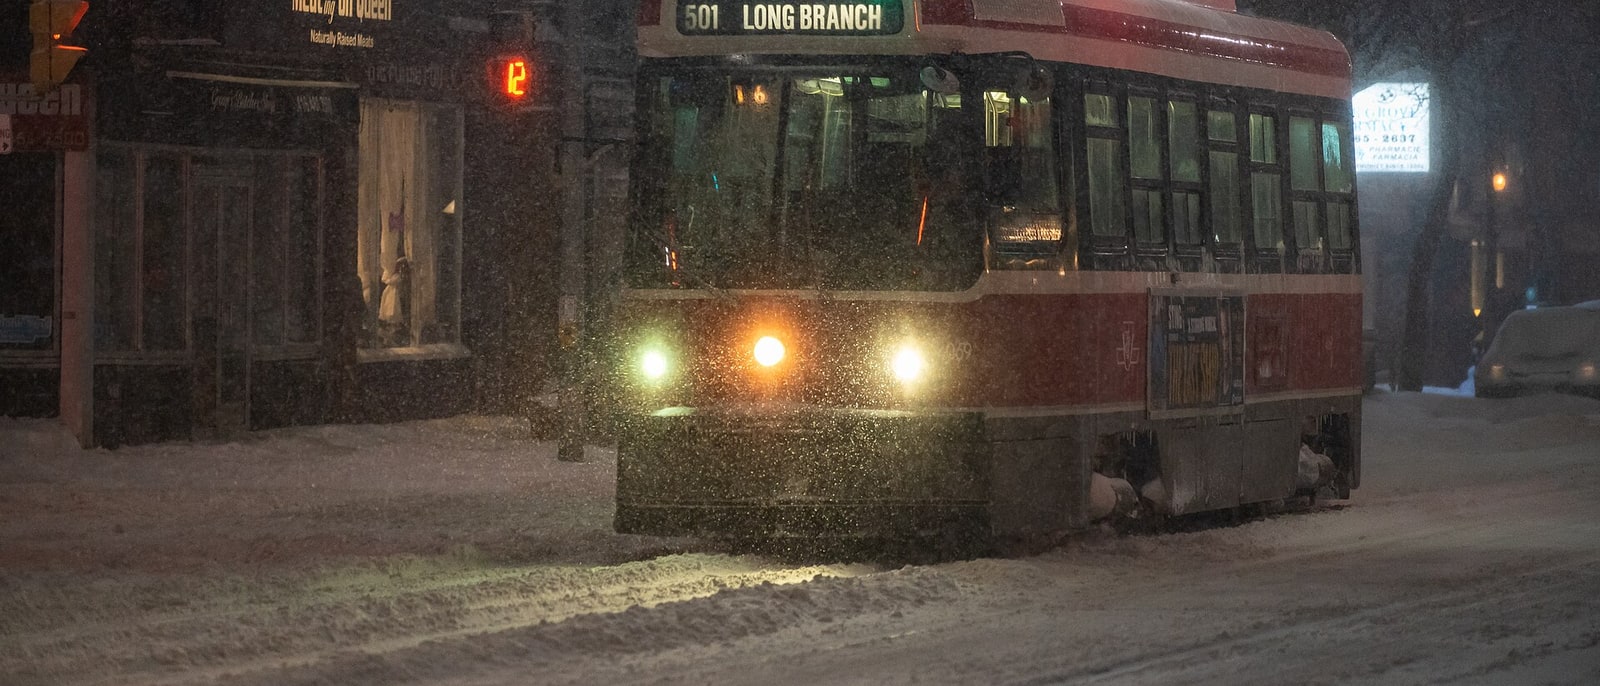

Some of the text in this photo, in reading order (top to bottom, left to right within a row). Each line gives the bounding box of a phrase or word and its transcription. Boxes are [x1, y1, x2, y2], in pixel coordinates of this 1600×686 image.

[356, 0, 391, 23] Queen
[685, 4, 881, 30] 501 LONG BRANCH
[310, 29, 374, 48] Naturally Raised Meats
[508, 62, 525, 95] 12
